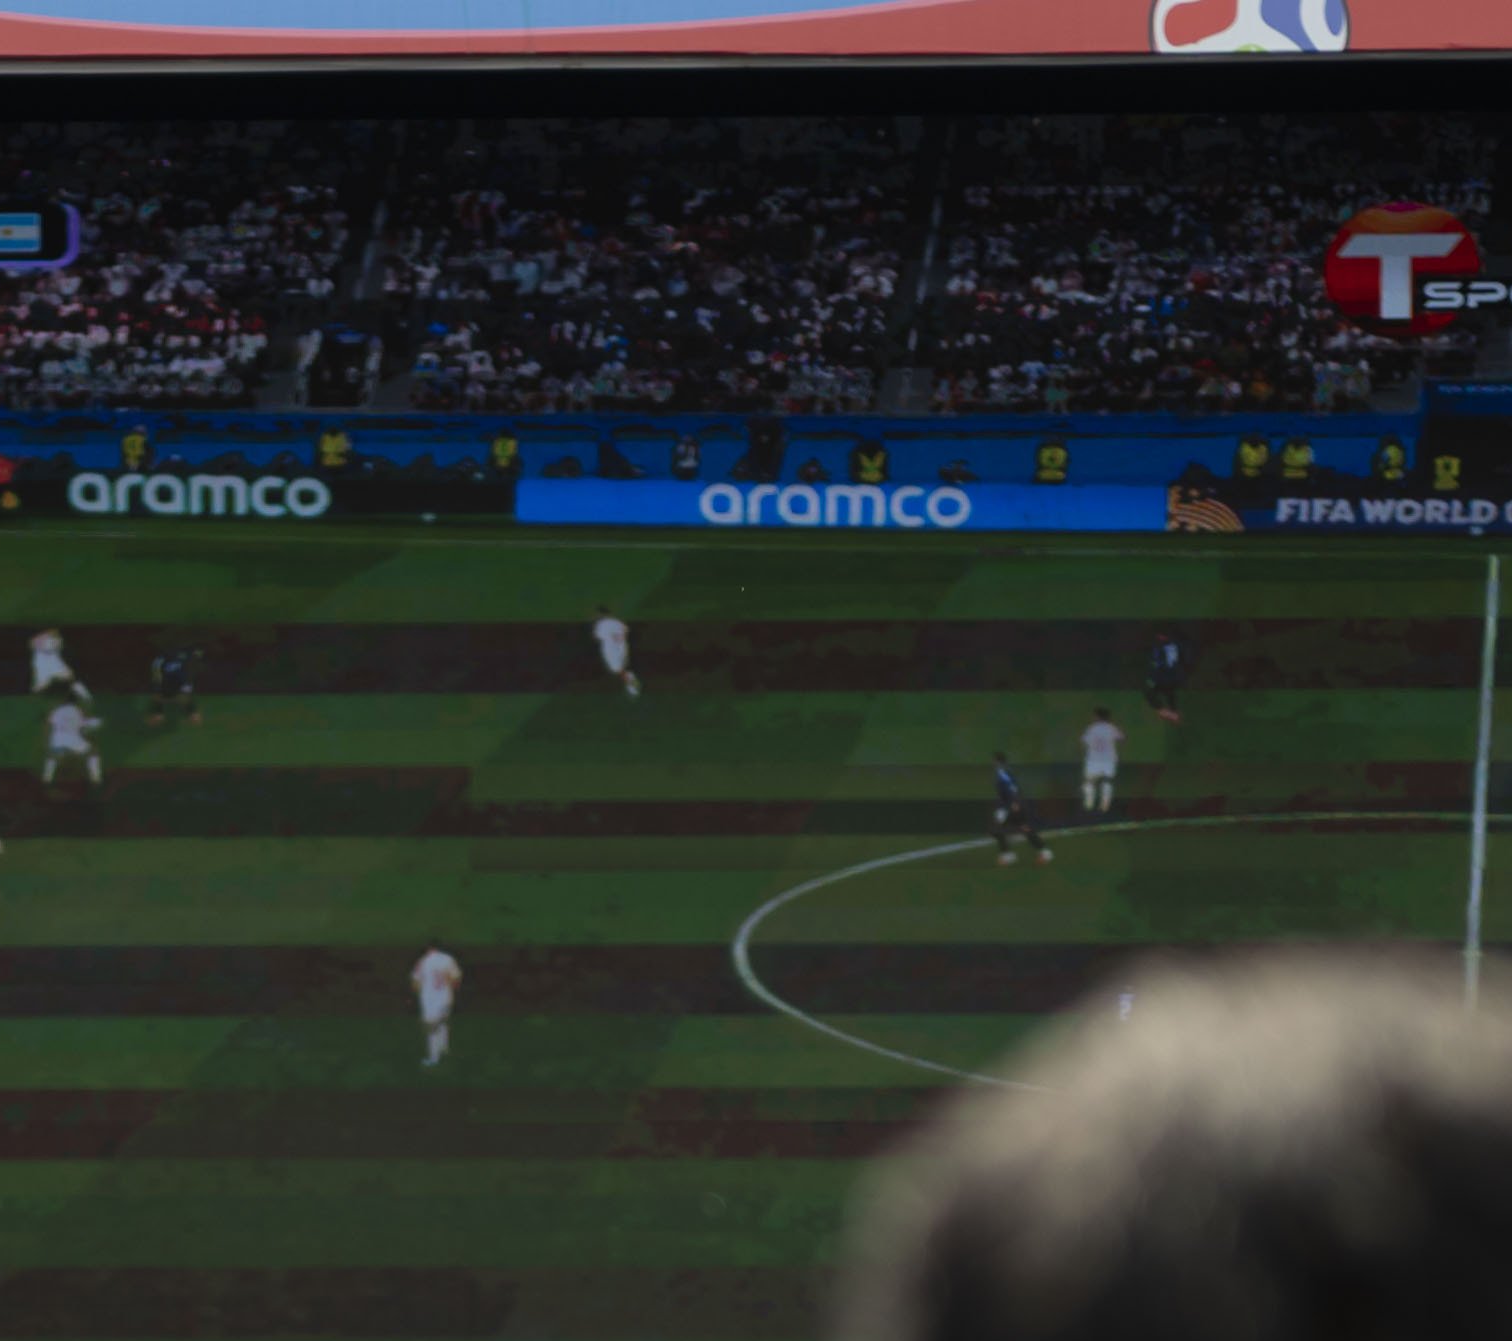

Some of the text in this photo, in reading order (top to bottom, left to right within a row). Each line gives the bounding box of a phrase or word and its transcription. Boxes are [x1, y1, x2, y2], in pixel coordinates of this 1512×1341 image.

[67, 472, 332, 518] aramco
[697, 482, 971, 527] aramco
[1276, 499, 1357, 524] FIFA
[1362, 499, 1498, 525] WORLD
